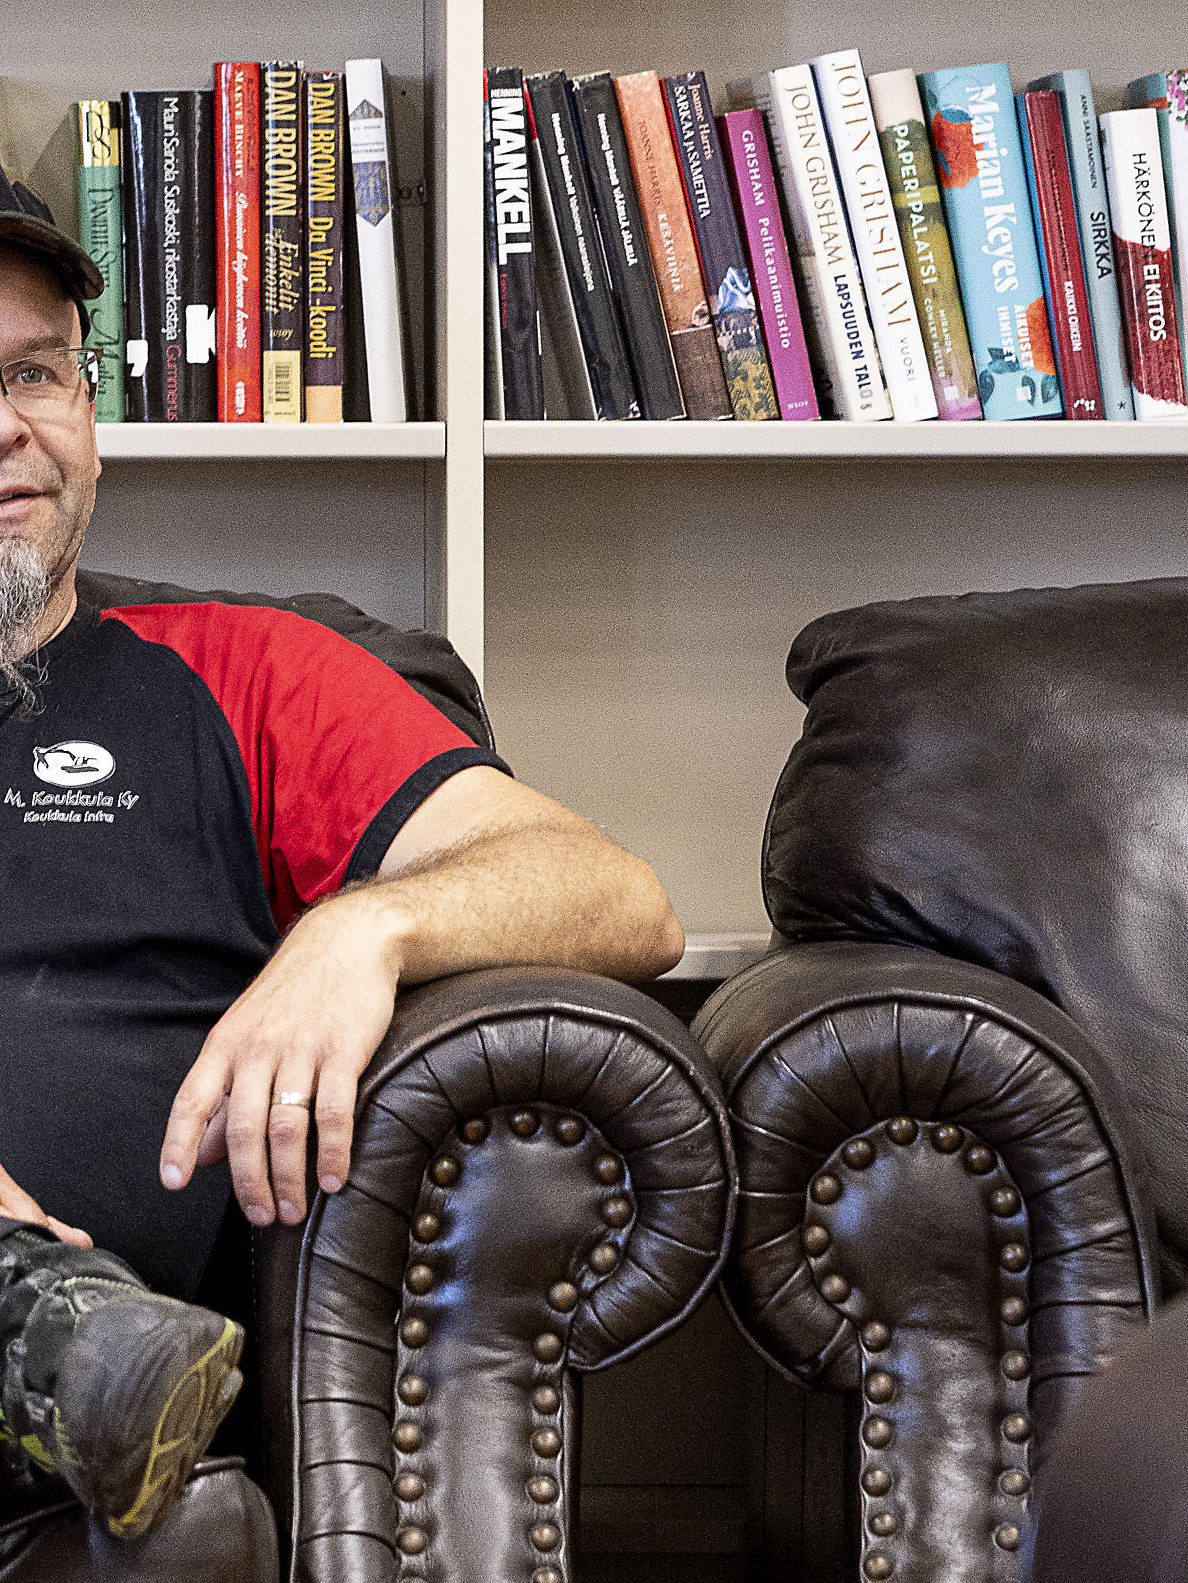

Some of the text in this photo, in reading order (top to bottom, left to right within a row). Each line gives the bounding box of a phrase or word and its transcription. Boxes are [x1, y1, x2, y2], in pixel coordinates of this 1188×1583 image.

[163, 97, 180, 136] Mauri
[234, 70, 244, 119] MAEVE
[490, 88, 522, 98] HENNING
[687, 83, 714, 160] Joanne Harris
[163, 137, 180, 182] Sariola
[235, 123, 244, 178] BINCHY
[264, 71, 297, 216] DAN BROWN
[490, 98, 532, 265] MANKELL
[551, 113, 566, 155] Henning
[561, 156, 575, 196] Mankell
[597, 113, 611, 151] Henning
[605, 150, 619, 185] Mankell
[673, 86, 693, 140] SARKAA
[686, 152, 711, 219] SAMETTIA
[309, 83, 335, 359] DAN BROWN Da Vinci -koodi
[638, 121, 654, 162] JOANNE
[658, 213, 683, 293] KESÄVIINIÄ
[831, 63, 911, 327] JOHN GRISHAM
[893, 123, 938, 285] PAPERIPALATSI
[965, 83, 1019, 294] Marian Keyes
[1133, 152, 1159, 260] HÄRKÖNEN
[275, 239, 300, 313] Enkelit
[742, 130, 790, 349] GRISHAM Pelikaanimuistio
[784, 83, 872, 400] JOHN GRISHAM LAPSUUDEN TALO
[1089, 211, 1112, 280] SIRKKA
[997, 306, 1016, 364] IHMISET
[1064, 281, 1082, 351] KAIKKI OIKEIN
[1143, 264, 1167, 341] EI KIITOS
[166, 344, 181, 421] Gummerus
[4, 788, 139, 809] M. Koukkula Ky
[24, 810, 114, 823] Koukkula Infra
